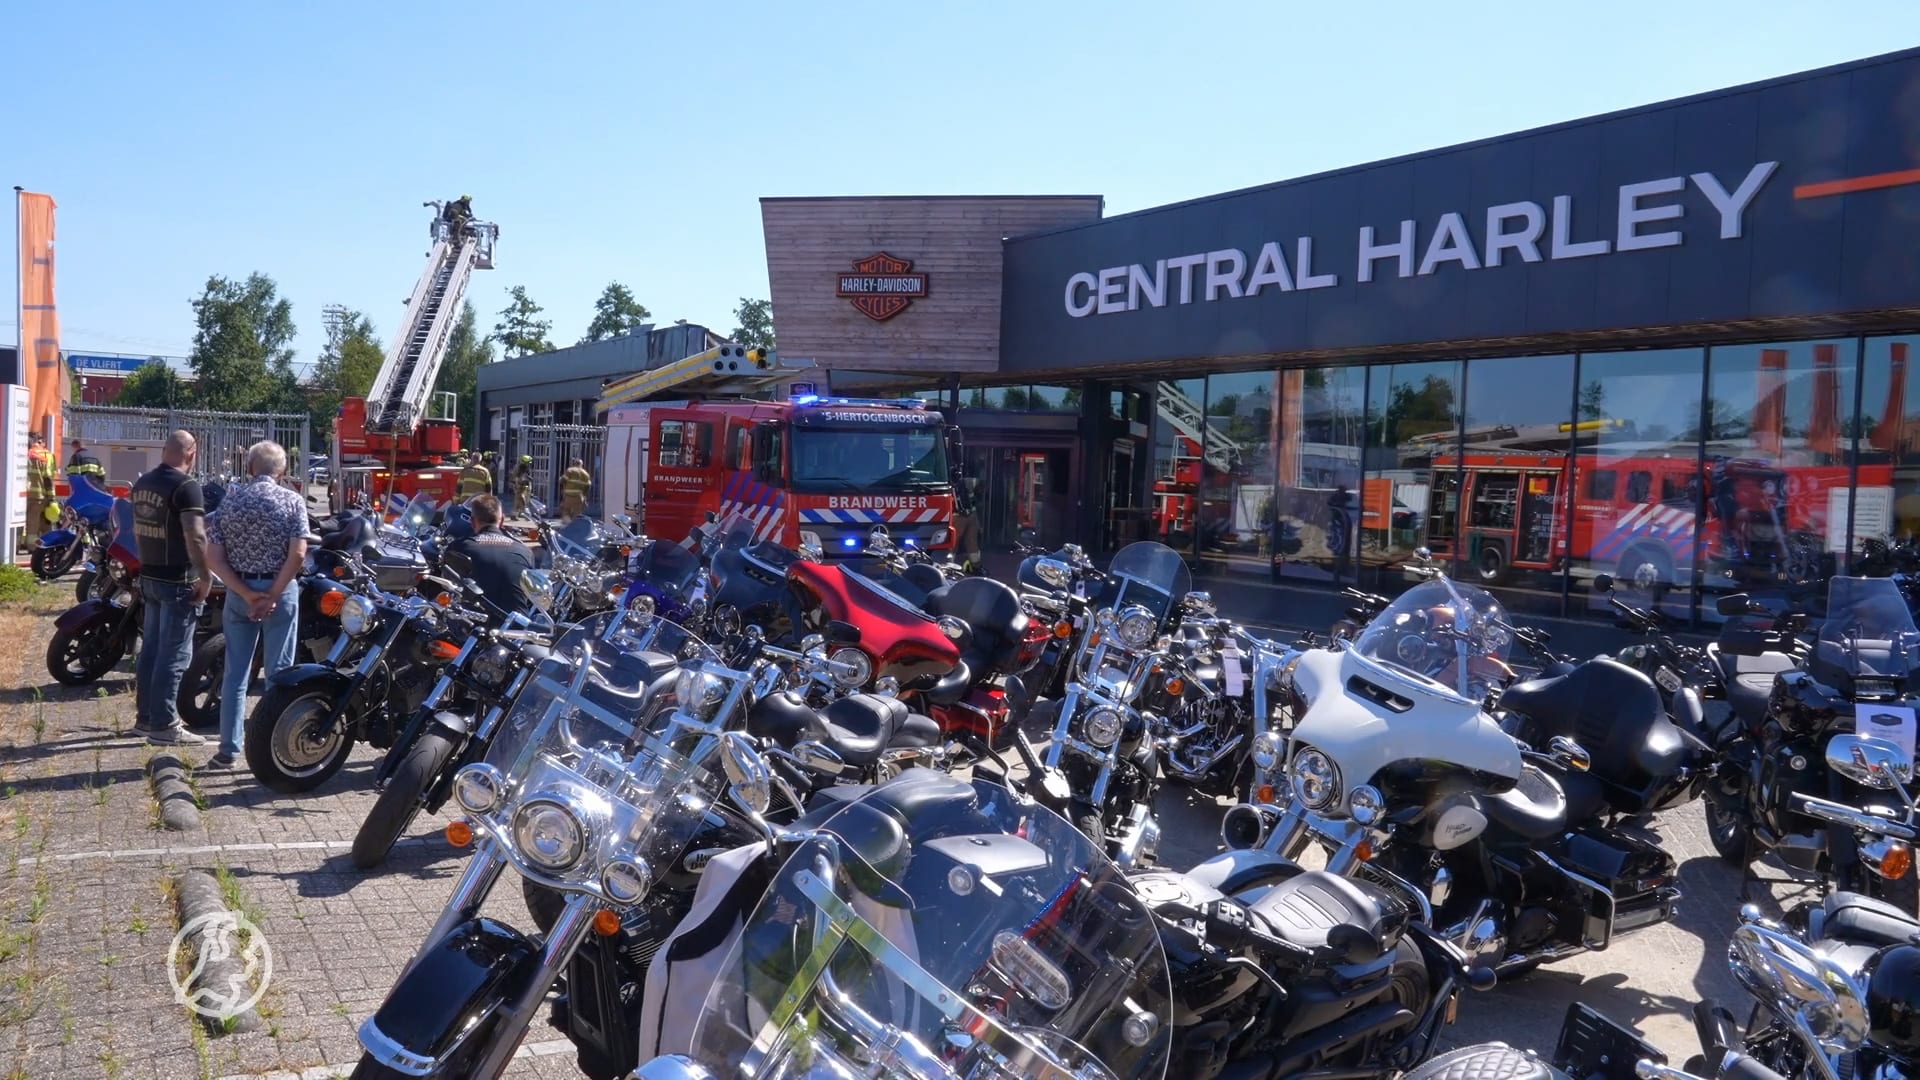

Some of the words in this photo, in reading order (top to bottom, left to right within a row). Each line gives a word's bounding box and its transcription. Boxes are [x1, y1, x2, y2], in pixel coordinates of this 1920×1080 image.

[1064, 236, 1338, 318] CENTRAL
[1356, 160, 1780, 283] HARLEY
[860, 258, 903, 274] MOTOR
[841, 277, 921, 293] HARLEY-DAVIDSON
[859, 297, 902, 317] CYCLES
[75, 358, 88, 368] DE
[822, 411, 927, 424] 'S-HERTOGENBOSCH
[654, 475, 704, 484] BRANDWEER
[828, 495, 928, 509] BRANDWEER
